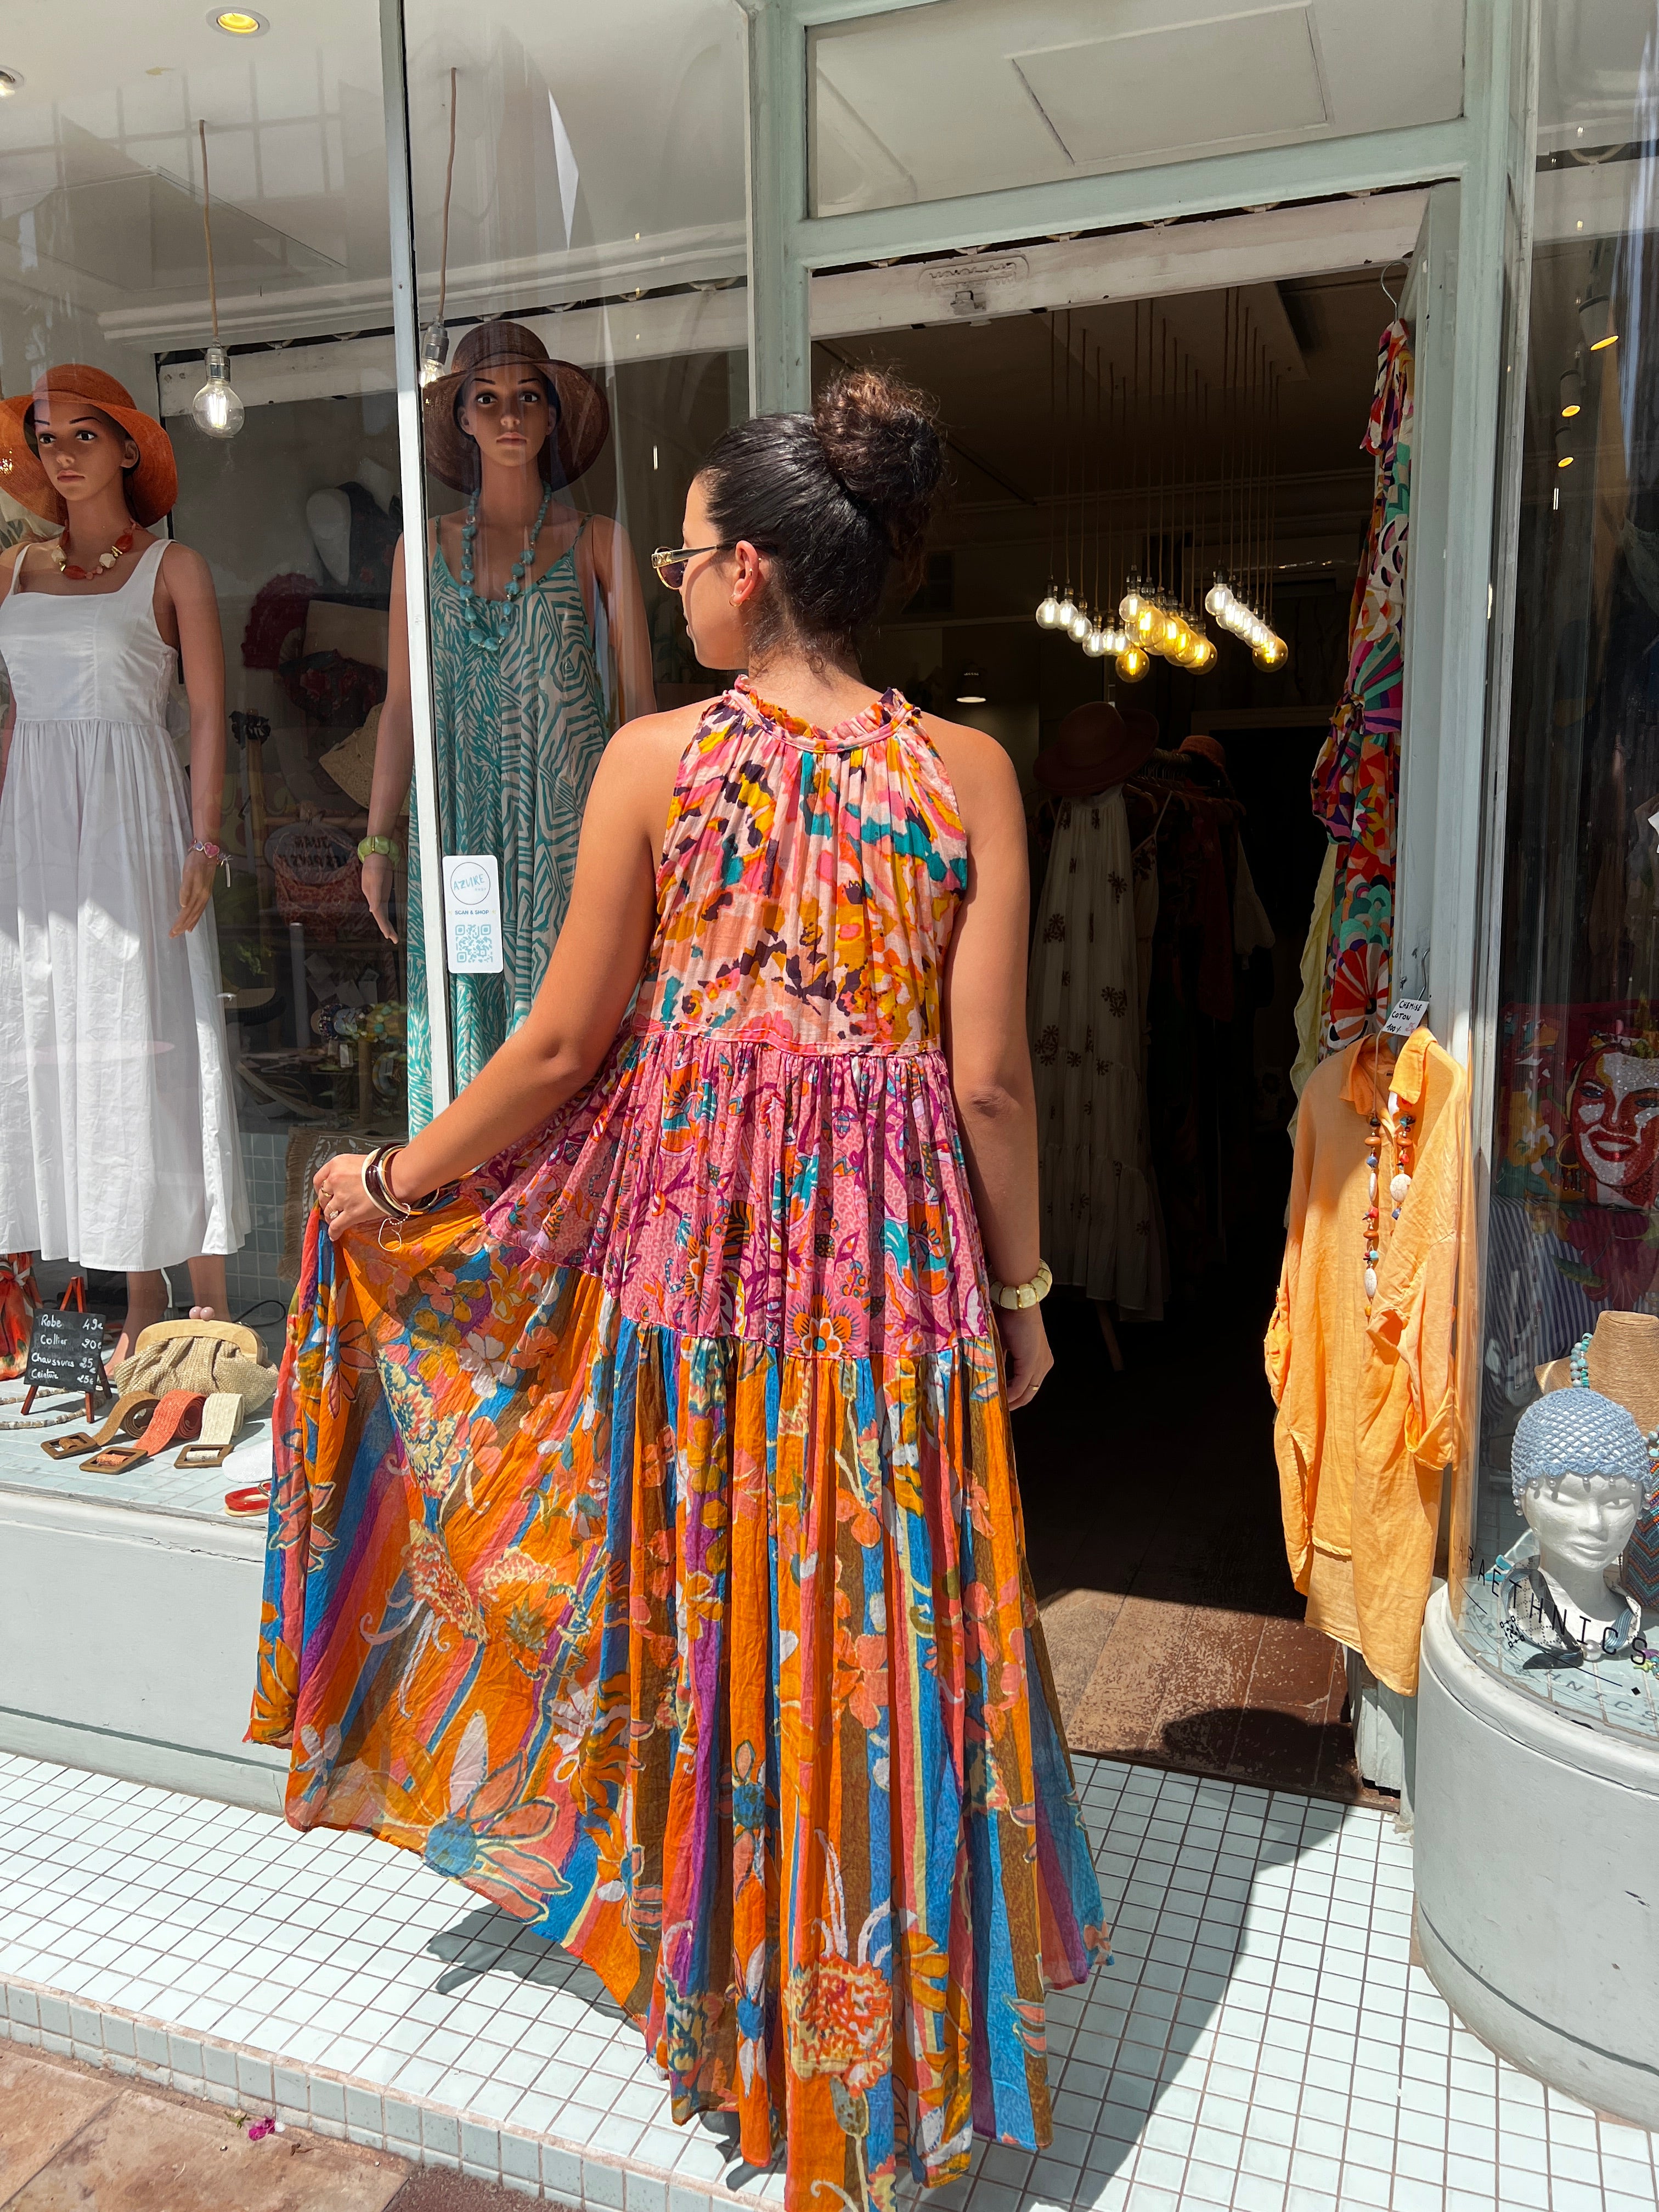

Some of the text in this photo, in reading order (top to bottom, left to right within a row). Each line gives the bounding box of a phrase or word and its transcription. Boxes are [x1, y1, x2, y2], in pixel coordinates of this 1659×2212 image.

[454, 874, 485, 890] AZURE
[1391, 1011, 1411, 1020] COTON
[41, 1314, 62, 1328] Robe
[40, 1333, 67, 1345] Collier
[31, 1352, 75, 1367] Chaussures
[31, 1368, 59, 1379] Ceinture
